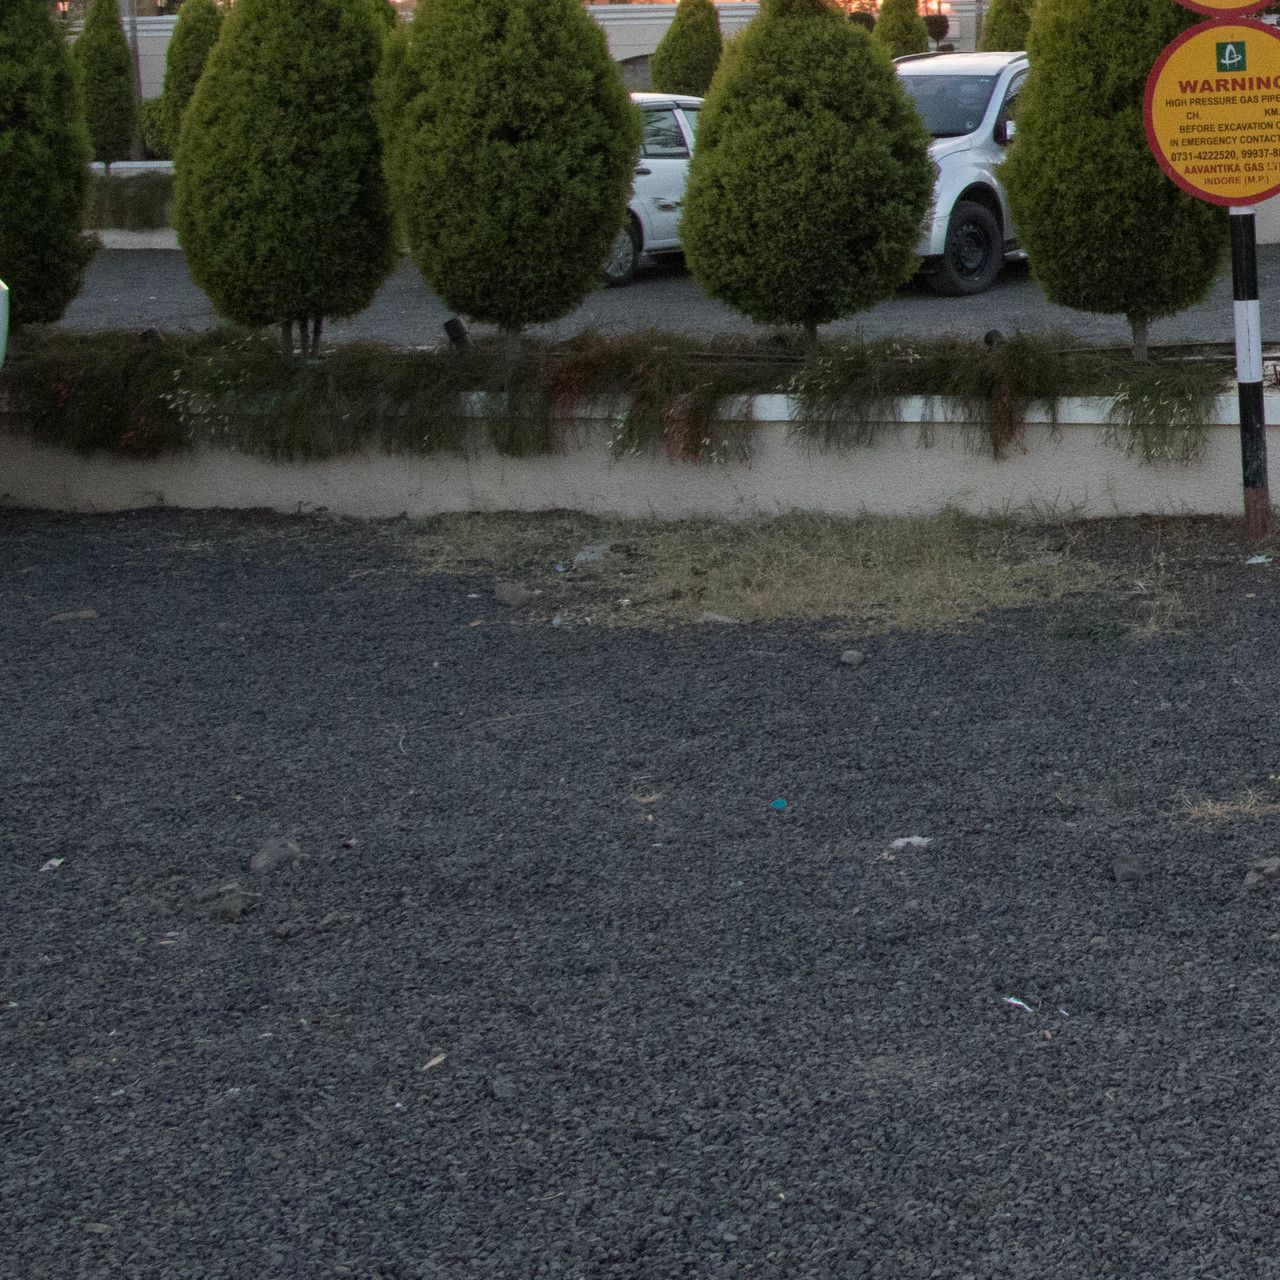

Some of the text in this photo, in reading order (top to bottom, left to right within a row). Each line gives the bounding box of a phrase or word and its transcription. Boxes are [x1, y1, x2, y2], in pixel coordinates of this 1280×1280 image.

[1166, 98, 1187, 107] HIGH
[1189, 95, 1237, 106] PRESSURE
[1240, 95, 1259, 104] GAS
[1264, 108, 1280, 116] KM.
[1179, 124, 1215, 133] BEFORE
[1218, 122, 1273, 132] EXCAVATION
[1170, 138, 1179, 147] IN
[1181, 136, 1238, 146] EMERGENCY
[1240, 134, 1280, 144] CONTACT
[1171, 151, 1239, 162] 0731-4222520,
[1184, 163, 1240, 174] AAVANTIKA
[1244, 162, 1264, 172] GAS
[1204, 176, 1241, 185] INDORE
